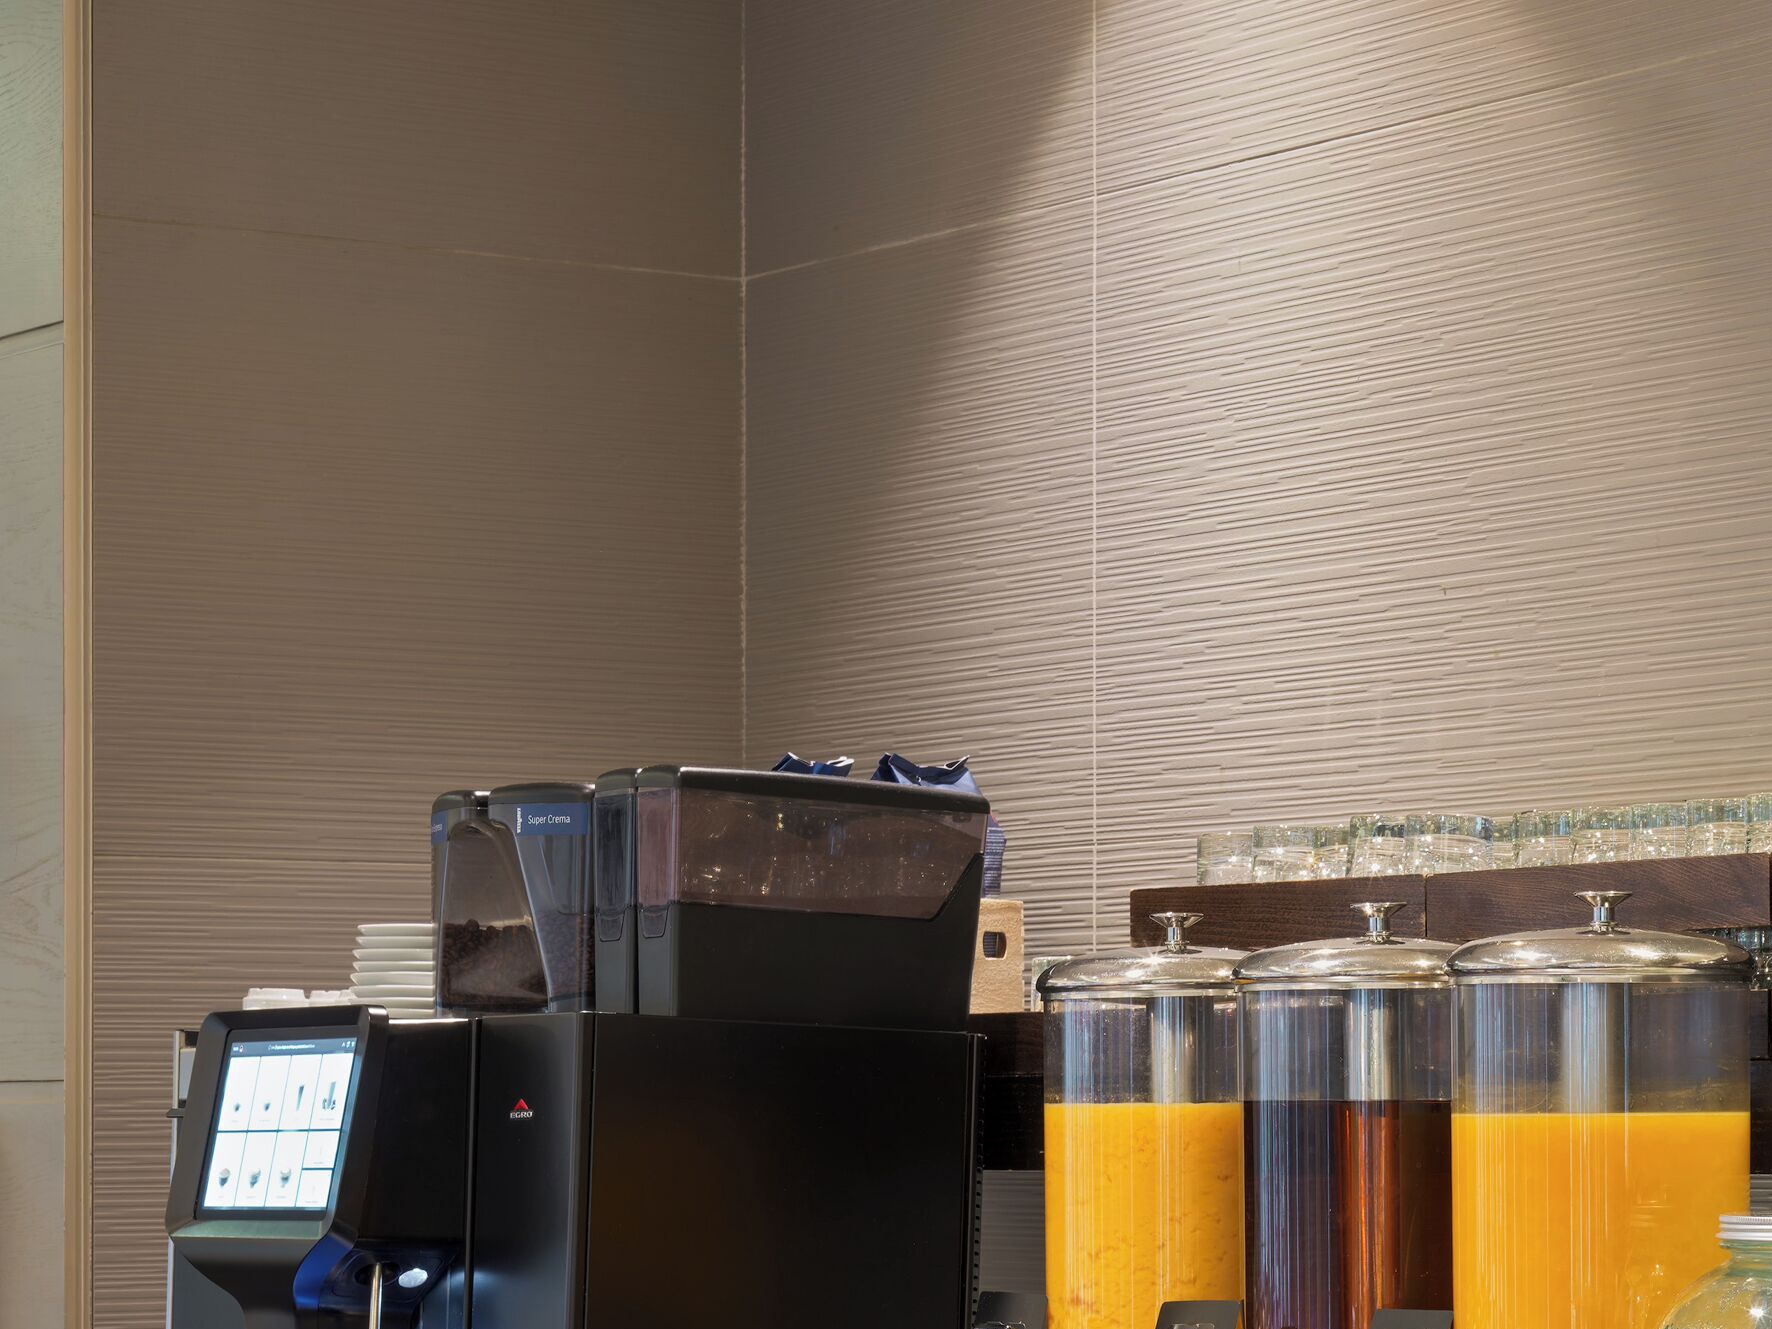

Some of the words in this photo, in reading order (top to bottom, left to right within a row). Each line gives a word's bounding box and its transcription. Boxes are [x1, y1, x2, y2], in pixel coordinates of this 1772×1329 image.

[527, 815, 547, 826] Super
[547, 814, 571, 825] Crema
[510, 1111, 533, 1119] EGRO
